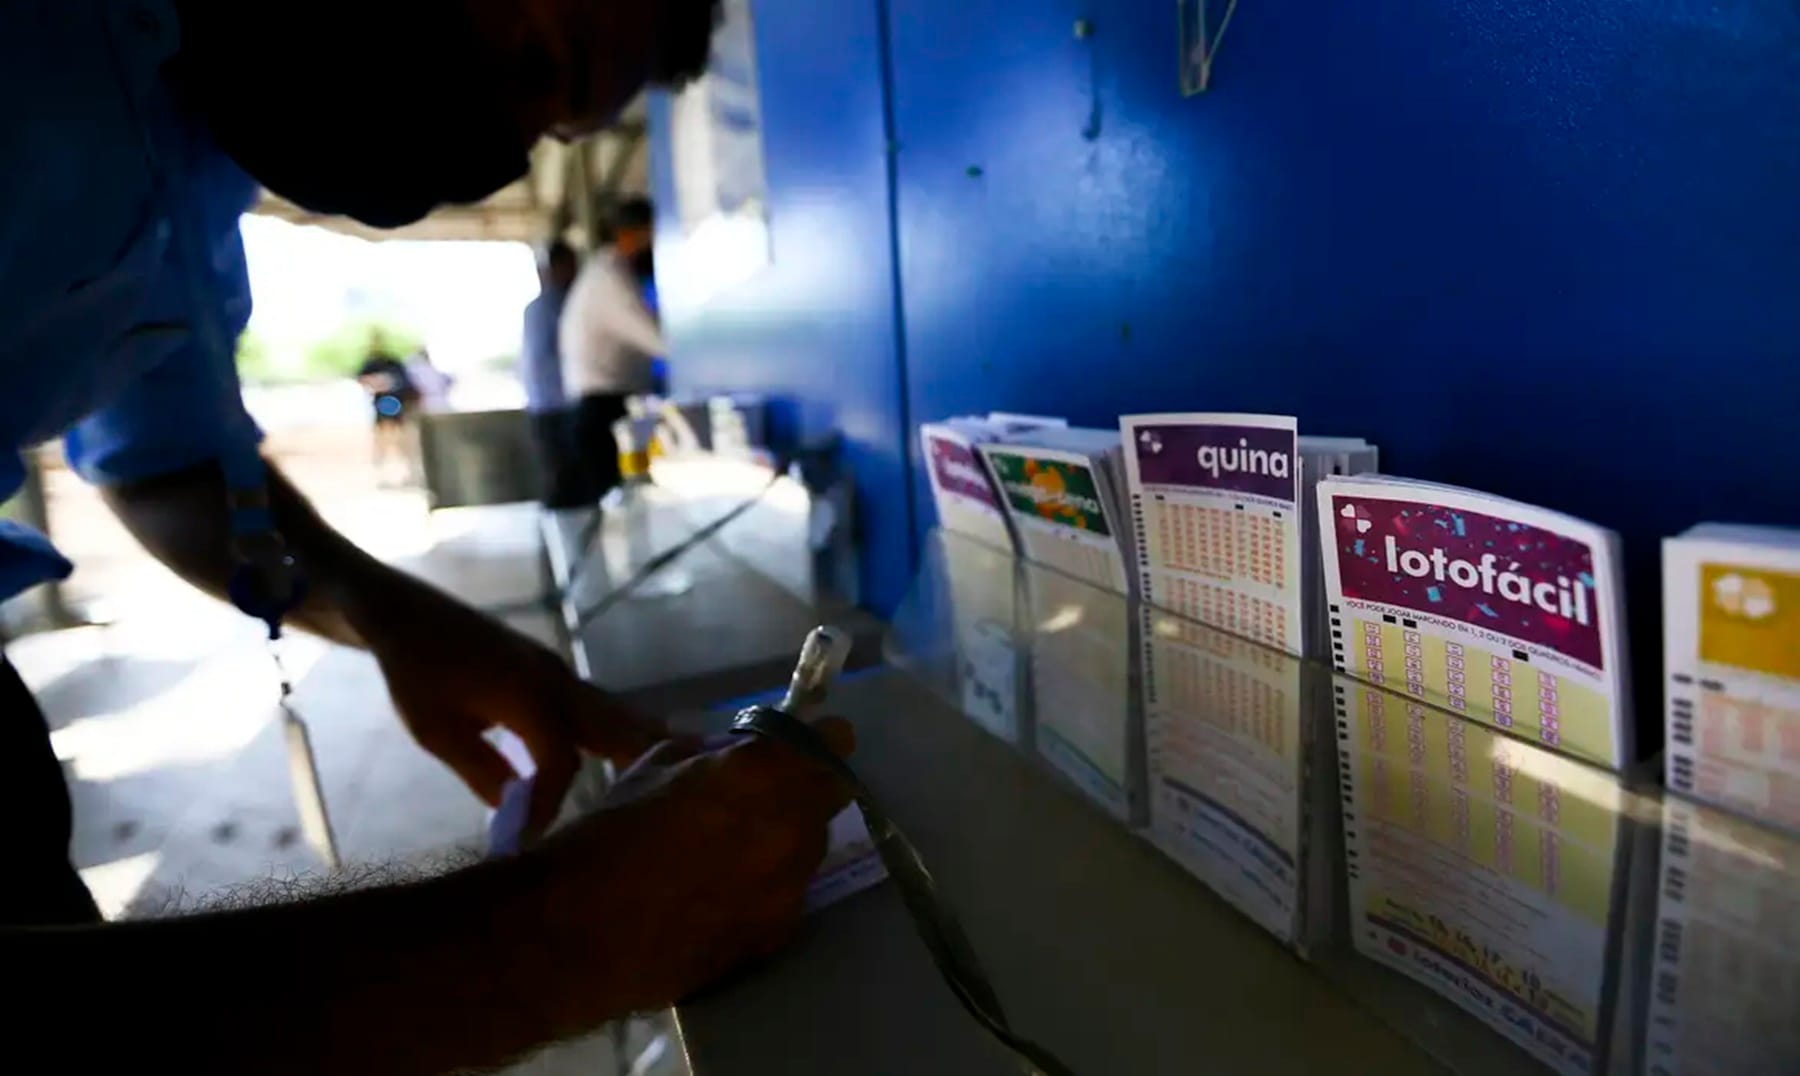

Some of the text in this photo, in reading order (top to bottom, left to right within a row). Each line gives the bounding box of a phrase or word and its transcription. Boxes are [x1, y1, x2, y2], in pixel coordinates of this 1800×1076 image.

[1198, 438, 1289, 479] quina
[1384, 534, 1589, 626] lotofácil
[1412, 612, 1456, 630] MARCANDO
